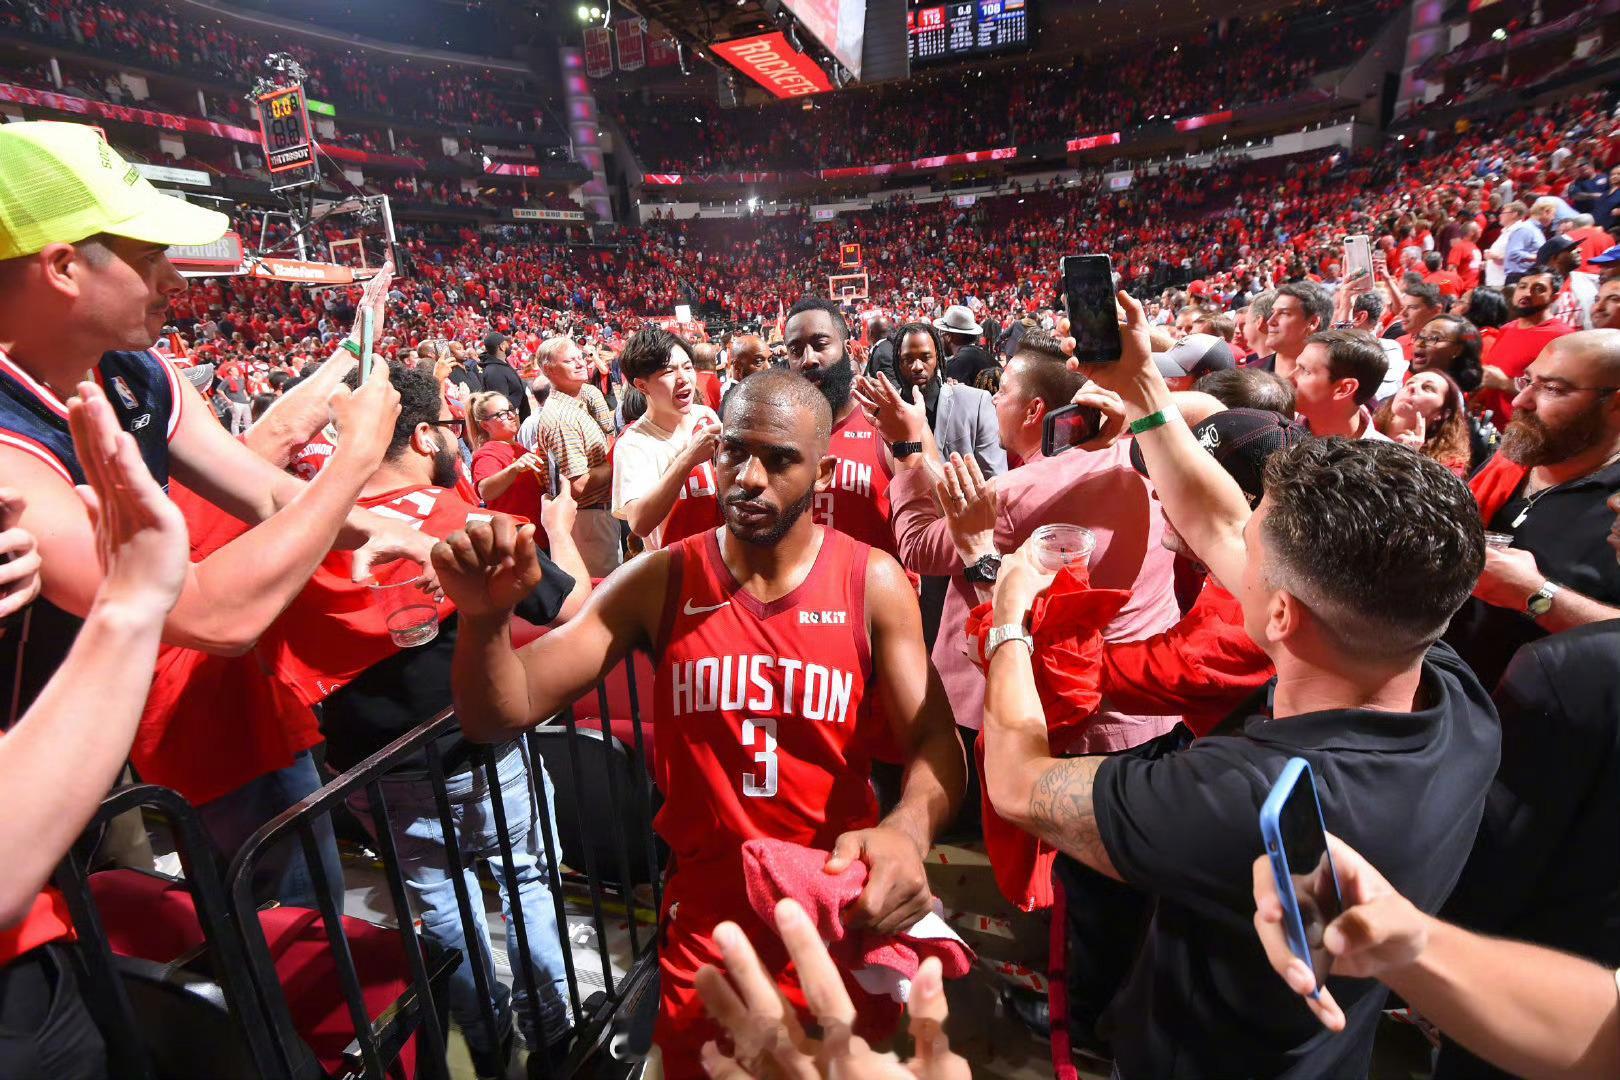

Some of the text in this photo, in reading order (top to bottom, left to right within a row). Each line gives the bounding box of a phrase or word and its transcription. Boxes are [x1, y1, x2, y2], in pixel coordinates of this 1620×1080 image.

[730, 39, 820, 96] ROCKETS
[672, 655, 853, 723] HOUSTON
[741, 718, 778, 797] 3
